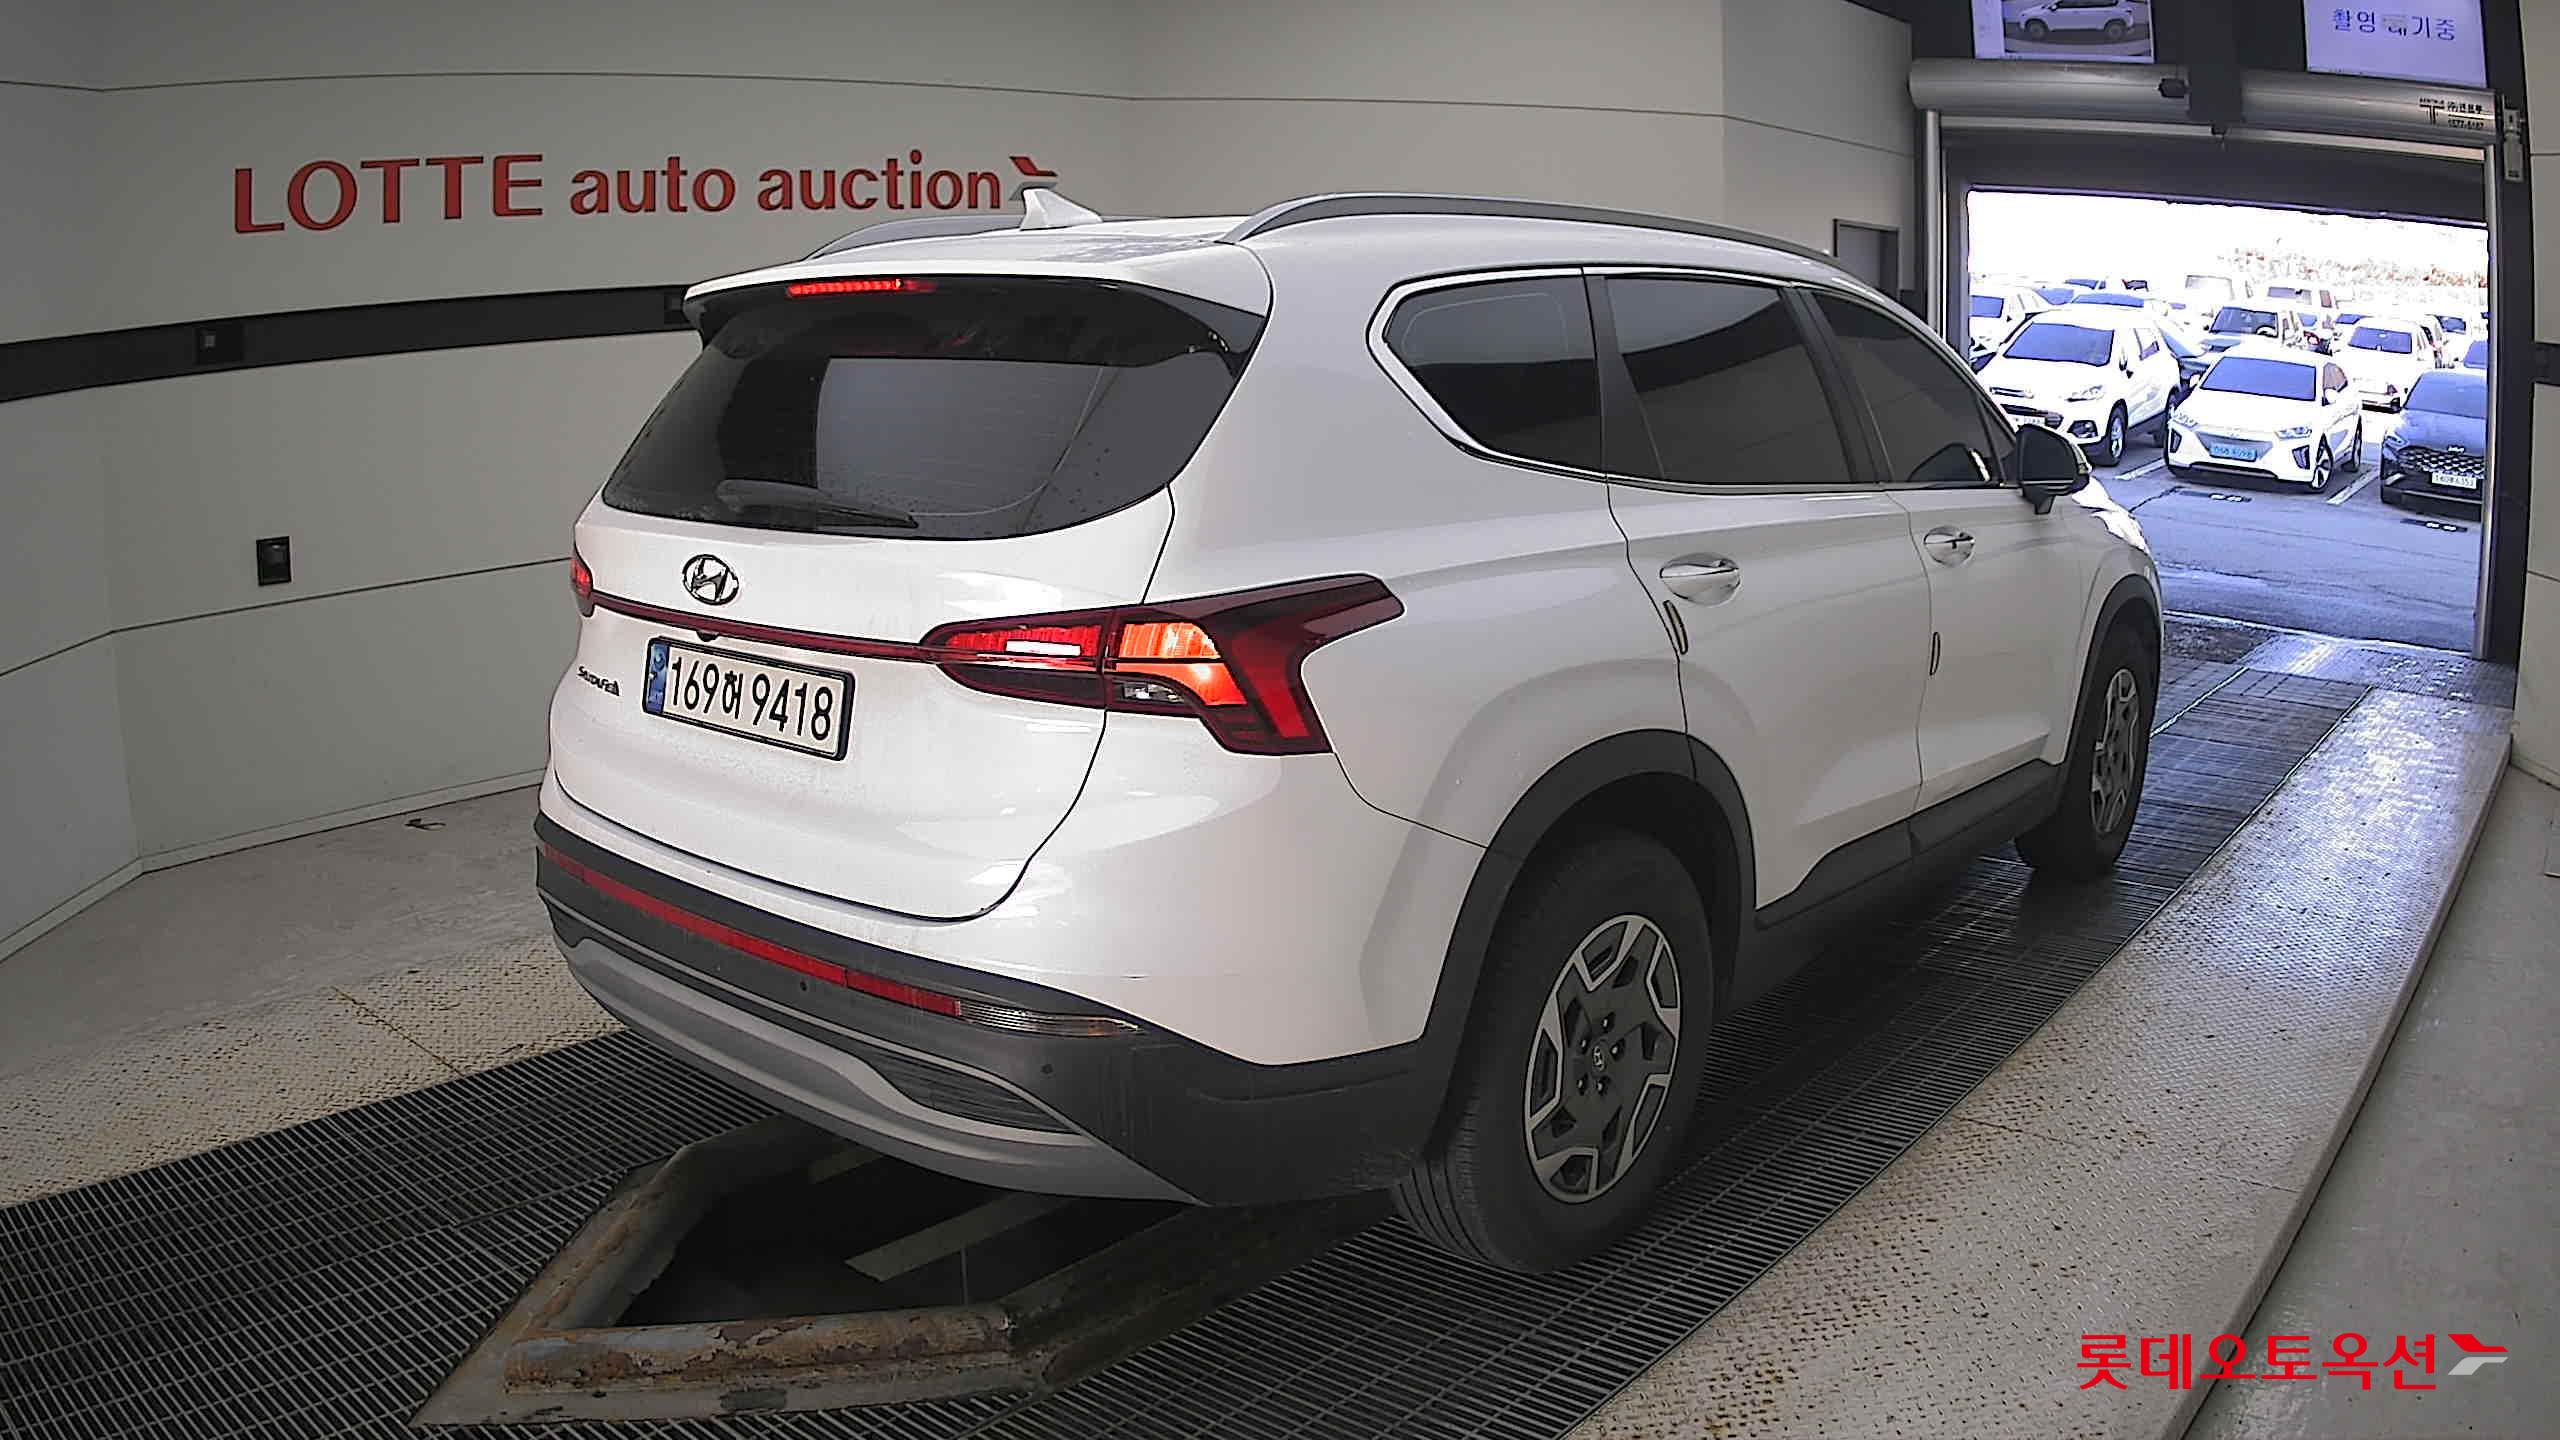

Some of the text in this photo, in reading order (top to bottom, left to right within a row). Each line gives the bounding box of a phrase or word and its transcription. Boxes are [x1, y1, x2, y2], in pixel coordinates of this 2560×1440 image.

[2333, 8, 2376, 33] 촬영
[234, 149, 1001, 234] LOTTE auto auction
[671, 656, 834, 741] 169허 9418
